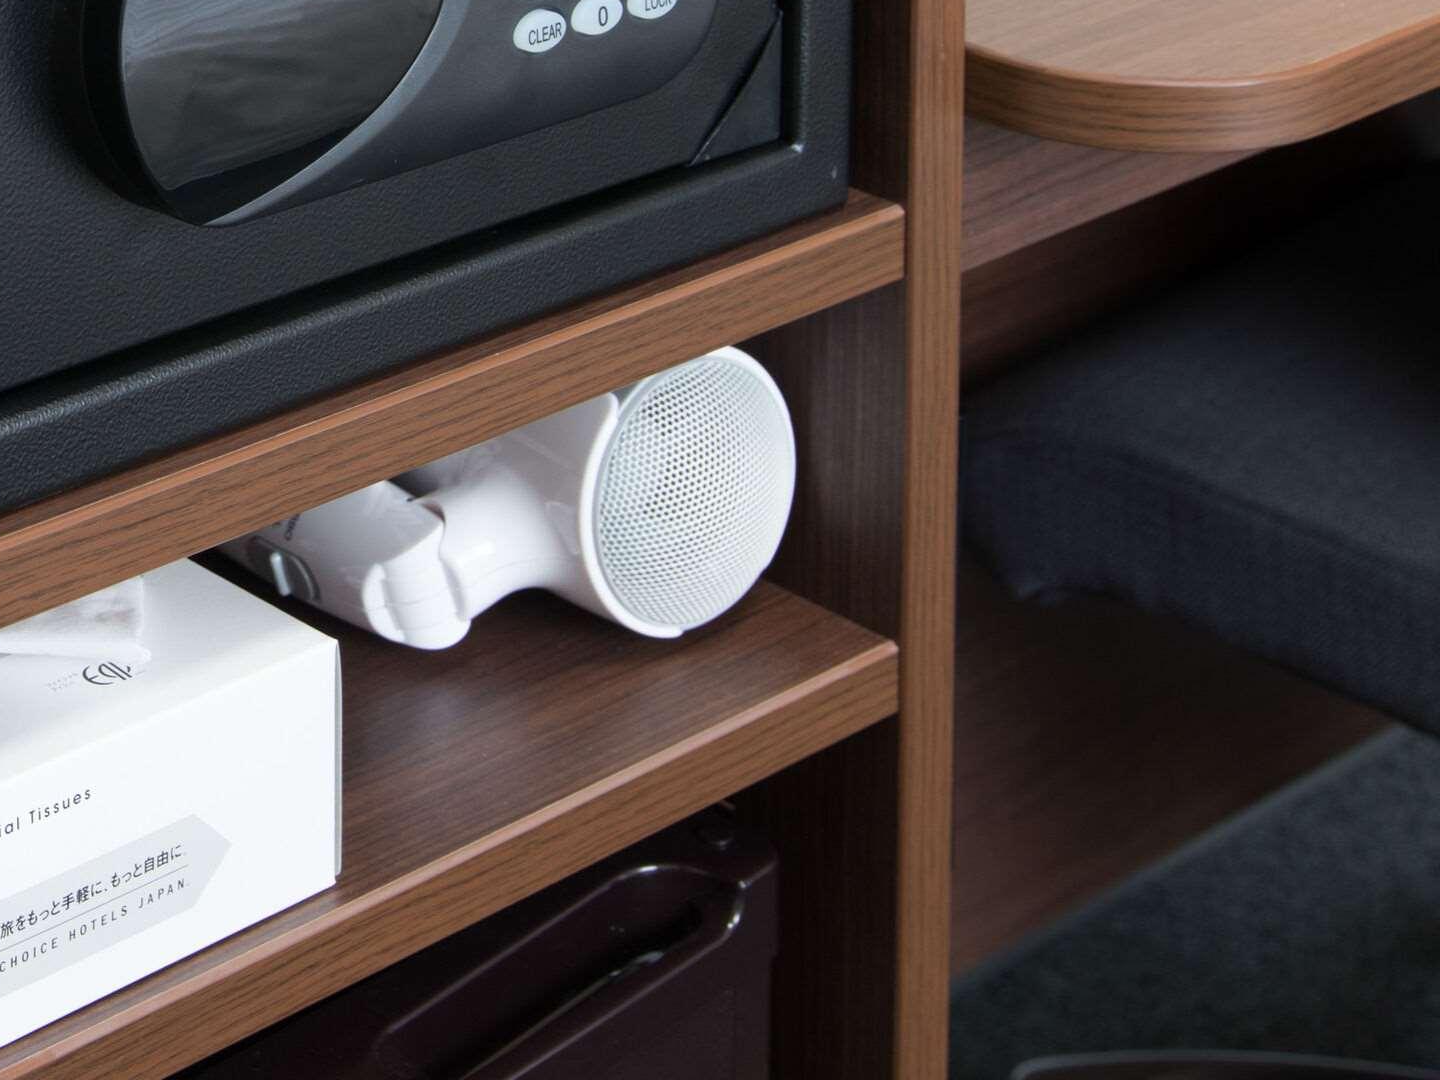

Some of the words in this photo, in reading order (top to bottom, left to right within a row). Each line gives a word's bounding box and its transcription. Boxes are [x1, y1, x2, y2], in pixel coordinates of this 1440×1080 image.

[528, 22, 562, 46] CLEAR
[598, 6, 608, 27] 0
[29, 789, 91, 824] Tissues
[0, 937, 59, 973] CHOICE
[68, 905, 129, 942] HOTELS
[138, 878, 185, 909] JAPAN
